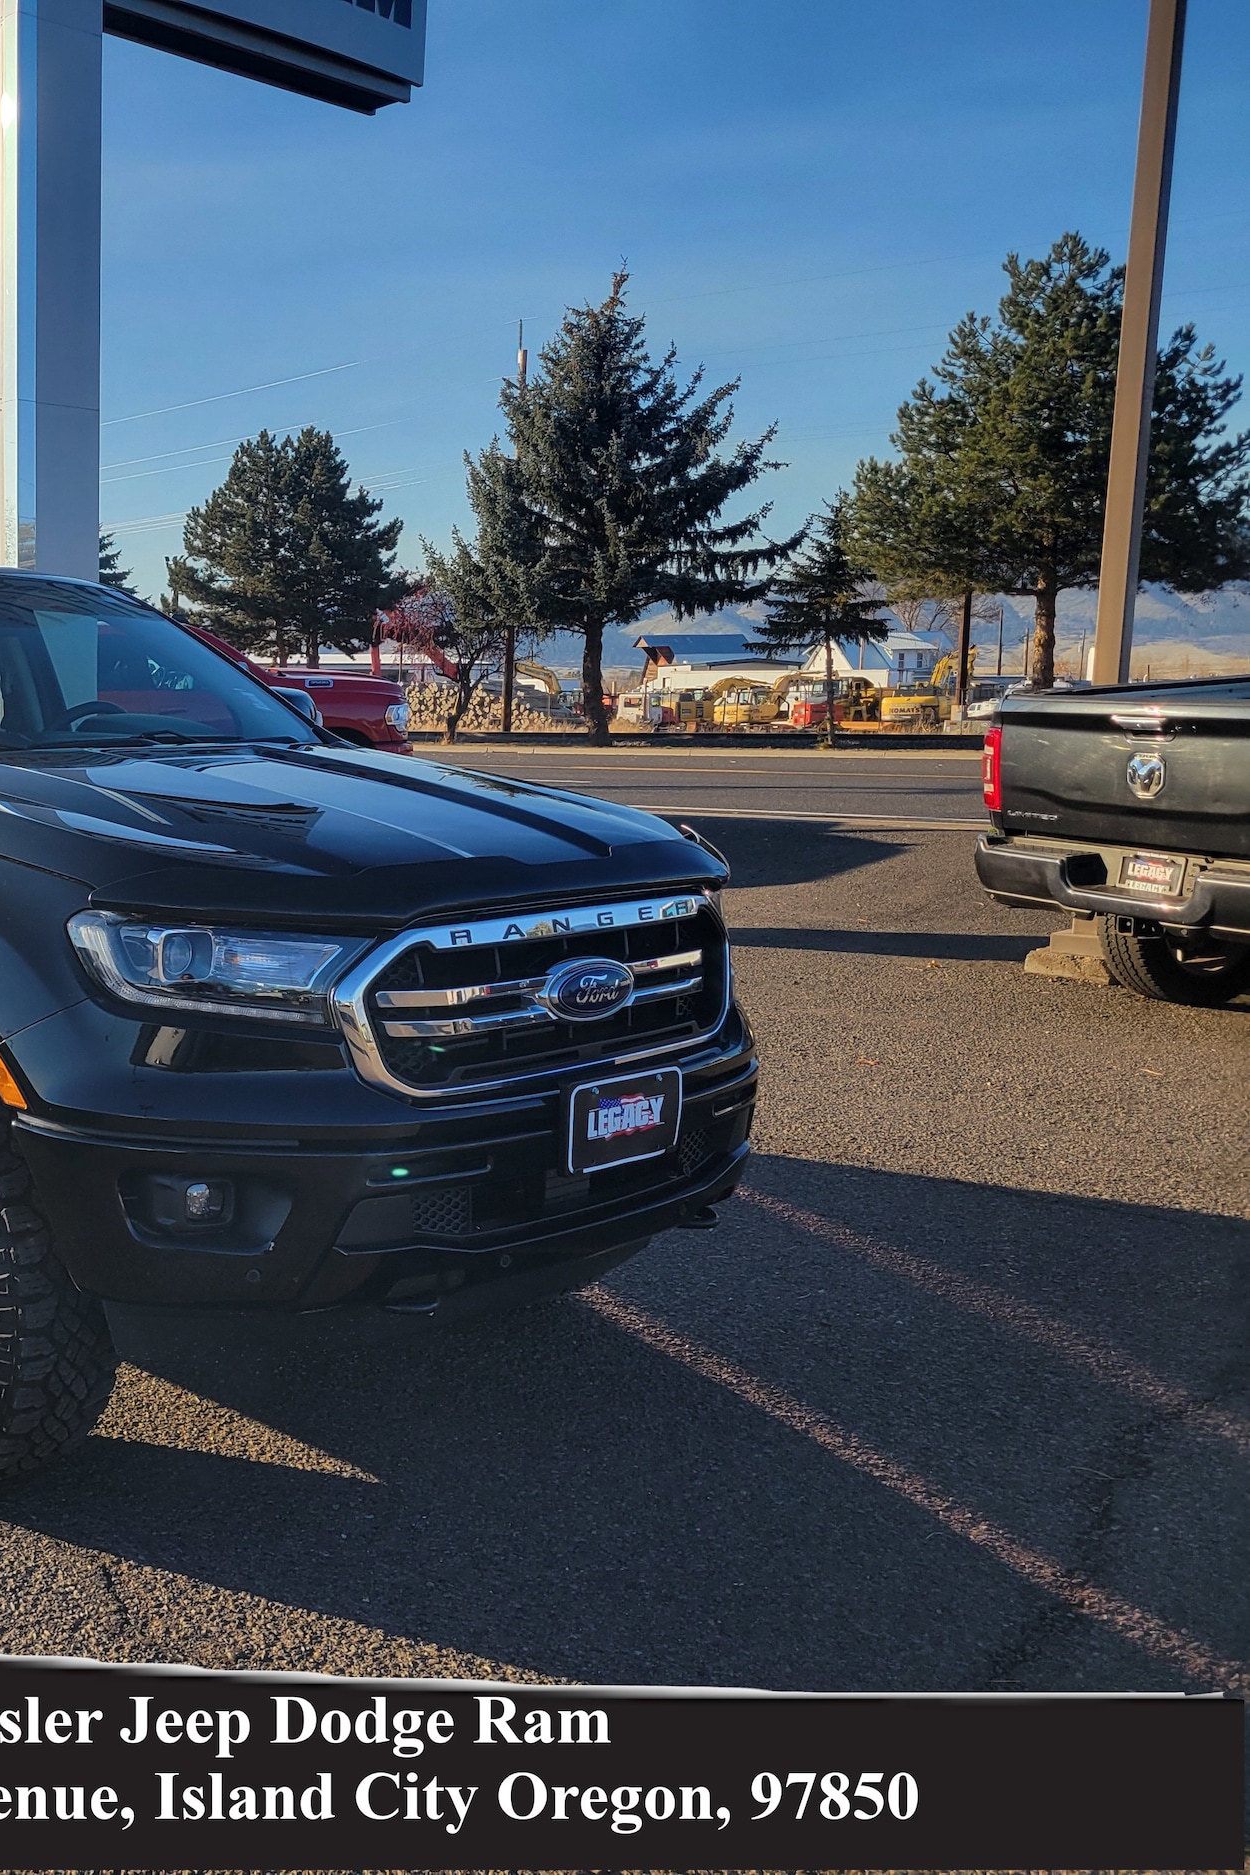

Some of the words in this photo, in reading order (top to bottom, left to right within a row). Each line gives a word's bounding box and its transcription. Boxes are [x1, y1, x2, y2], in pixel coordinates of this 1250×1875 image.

[1127, 861, 1174, 881] LEGACY
[451, 901, 689, 945] RANGER
[576, 974, 619, 1003] Ford
[587, 1097, 664, 1139] LEGACY
